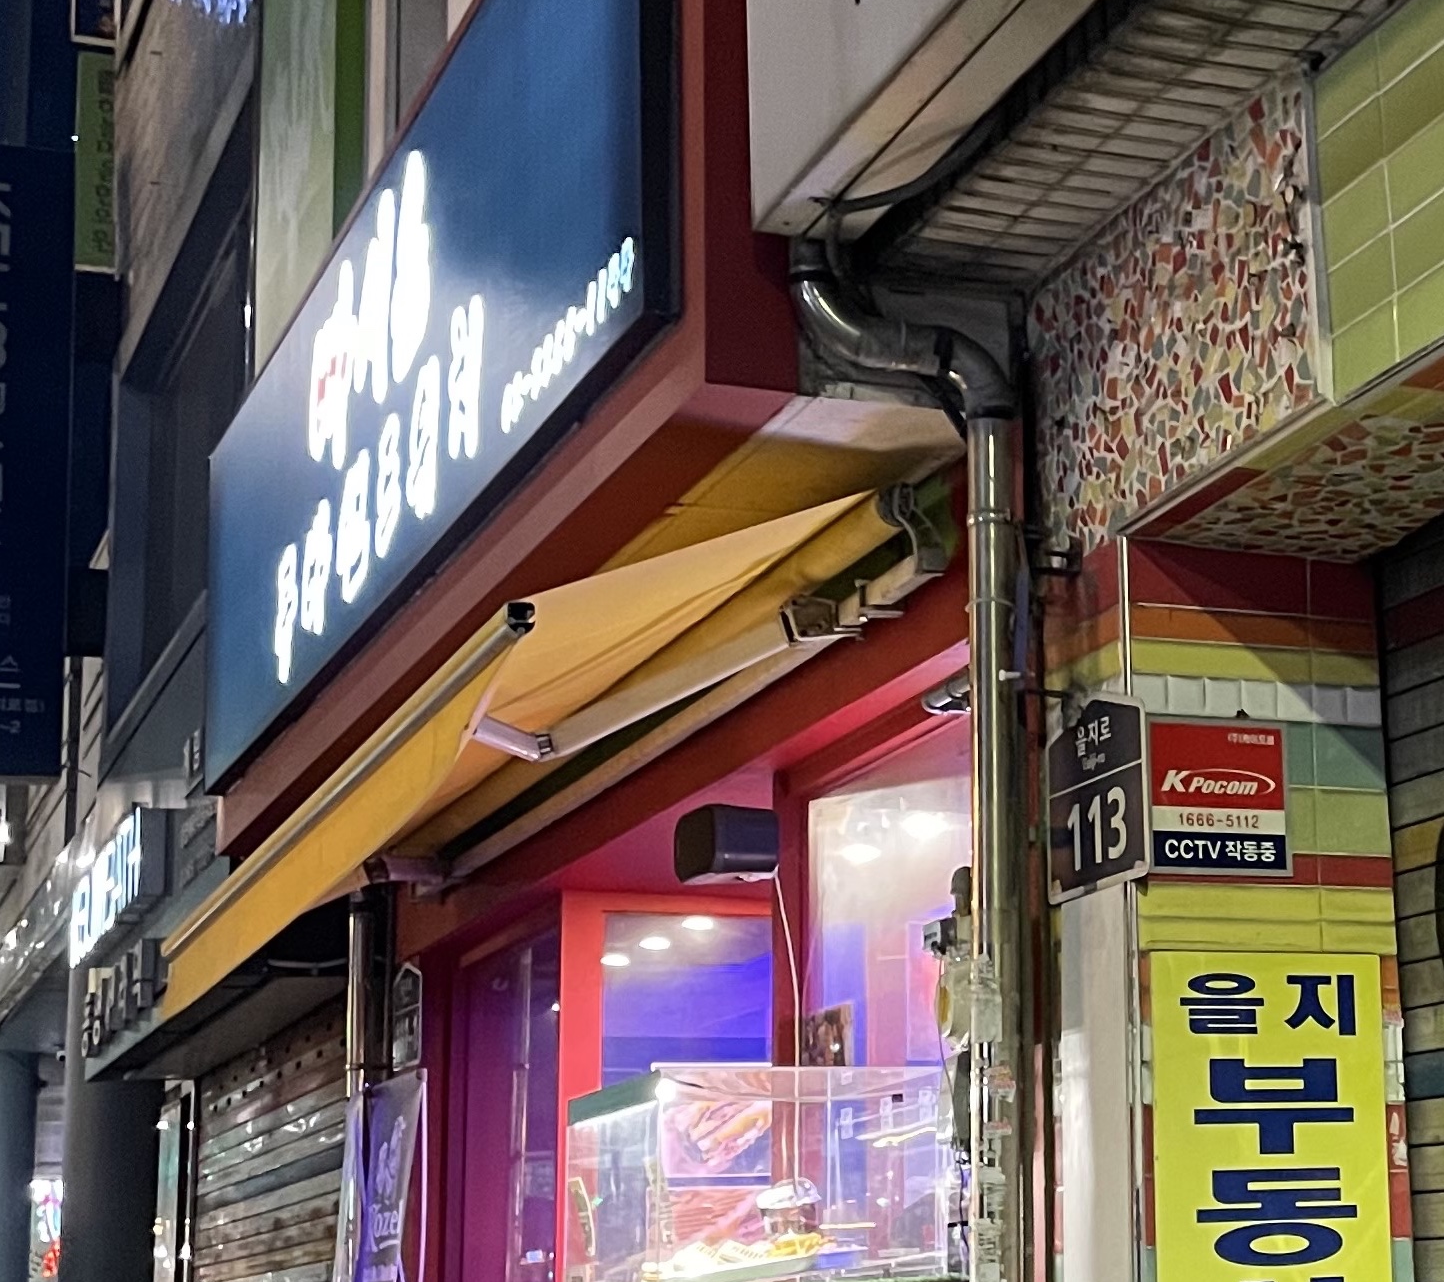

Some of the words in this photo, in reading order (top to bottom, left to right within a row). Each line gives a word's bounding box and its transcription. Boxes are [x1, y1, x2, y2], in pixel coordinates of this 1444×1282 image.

[1075, 716, 1111, 757] 을지로
[1067, 786, 1127, 872] 113
[1179, 812, 1259, 830] 1666-5112
[1164, 838, 1221, 860] CCTV
[1225, 839, 1276, 862] 작동중
[1179, 972, 1357, 1037] 을지
